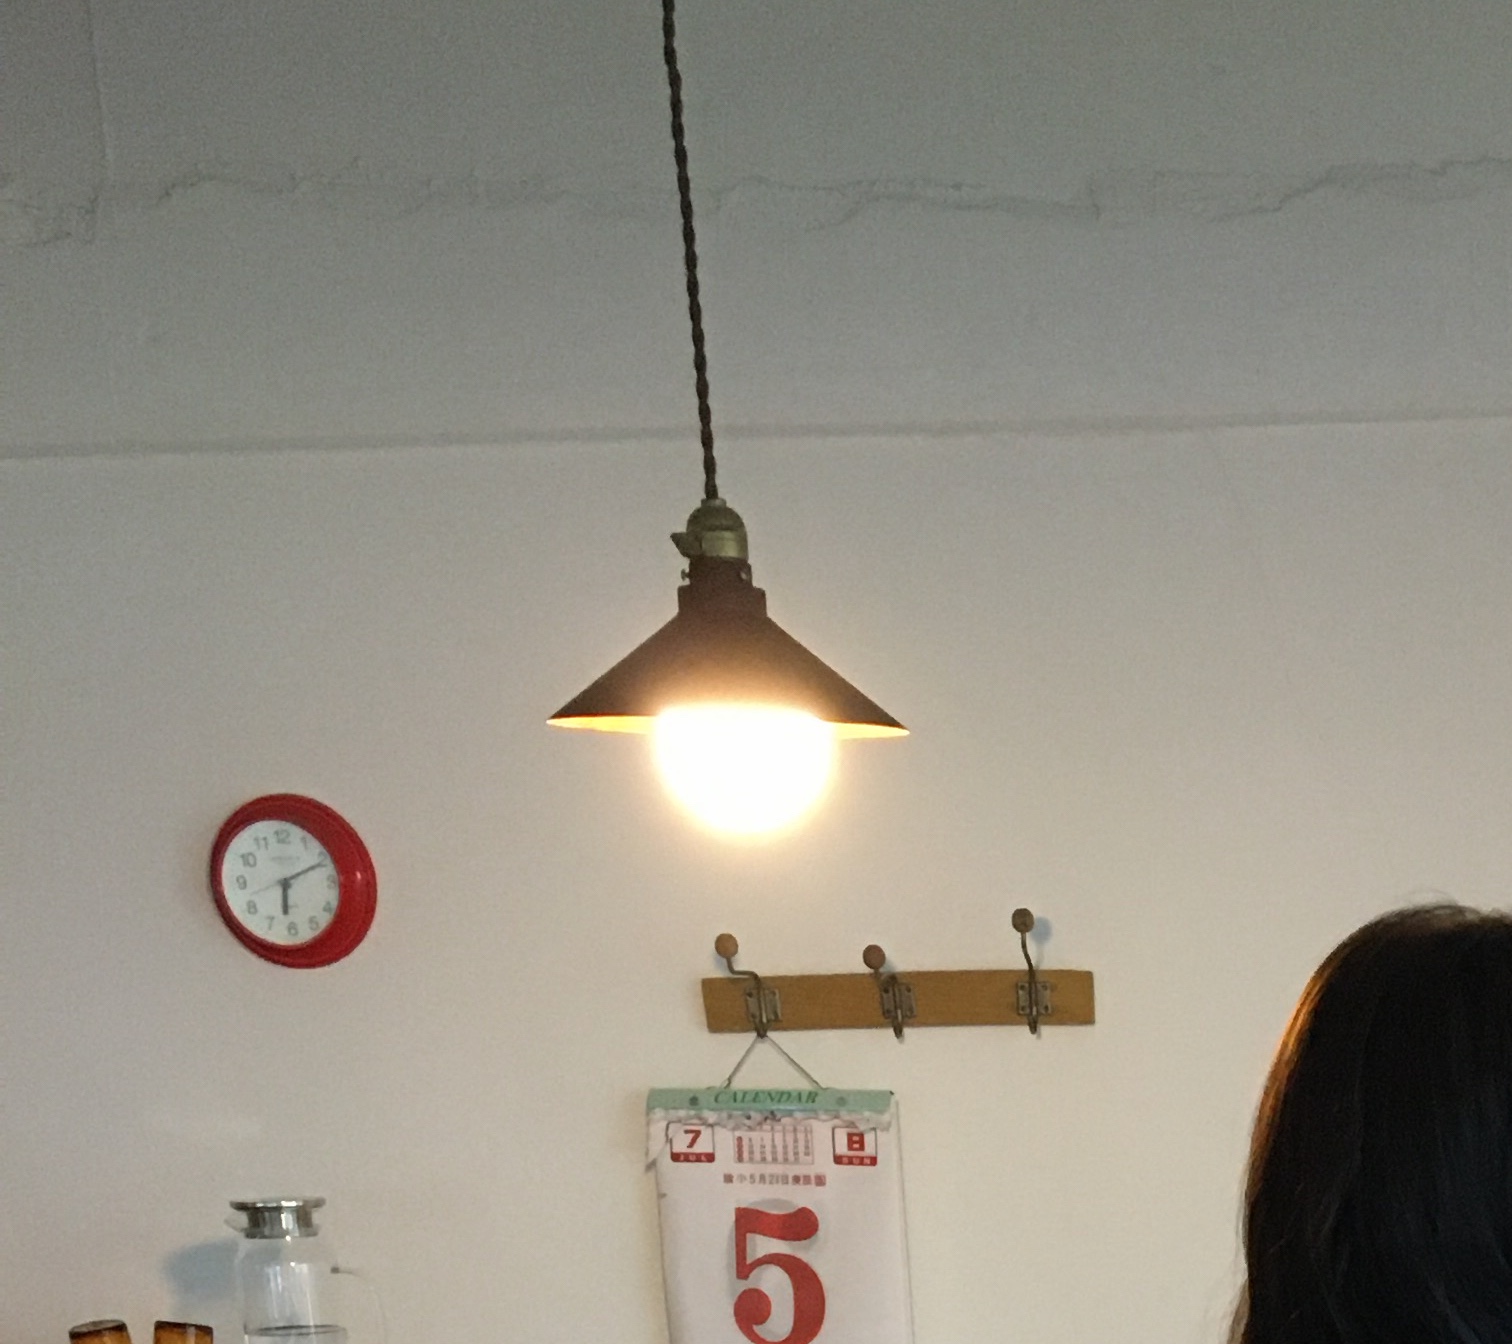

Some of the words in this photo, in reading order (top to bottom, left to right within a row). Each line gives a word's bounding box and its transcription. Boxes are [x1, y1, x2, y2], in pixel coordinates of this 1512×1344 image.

[253, 836, 268, 850] 11
[273, 829, 291, 844] 12
[300, 836, 308, 850] 1
[240, 852, 257, 867] 10
[236, 875, 247, 890] 9
[326, 874, 337, 889] 3
[246, 900, 258, 915] 8
[322, 901, 333, 915] 4
[266, 916, 275, 930] 7
[287, 921, 299, 936] 6
[308, 915, 319, 931] 5
[713, 1090, 819, 1103] CALENDAR
[683, 1130, 701, 1148] 7
[842, 1157, 870, 1165] SUN
